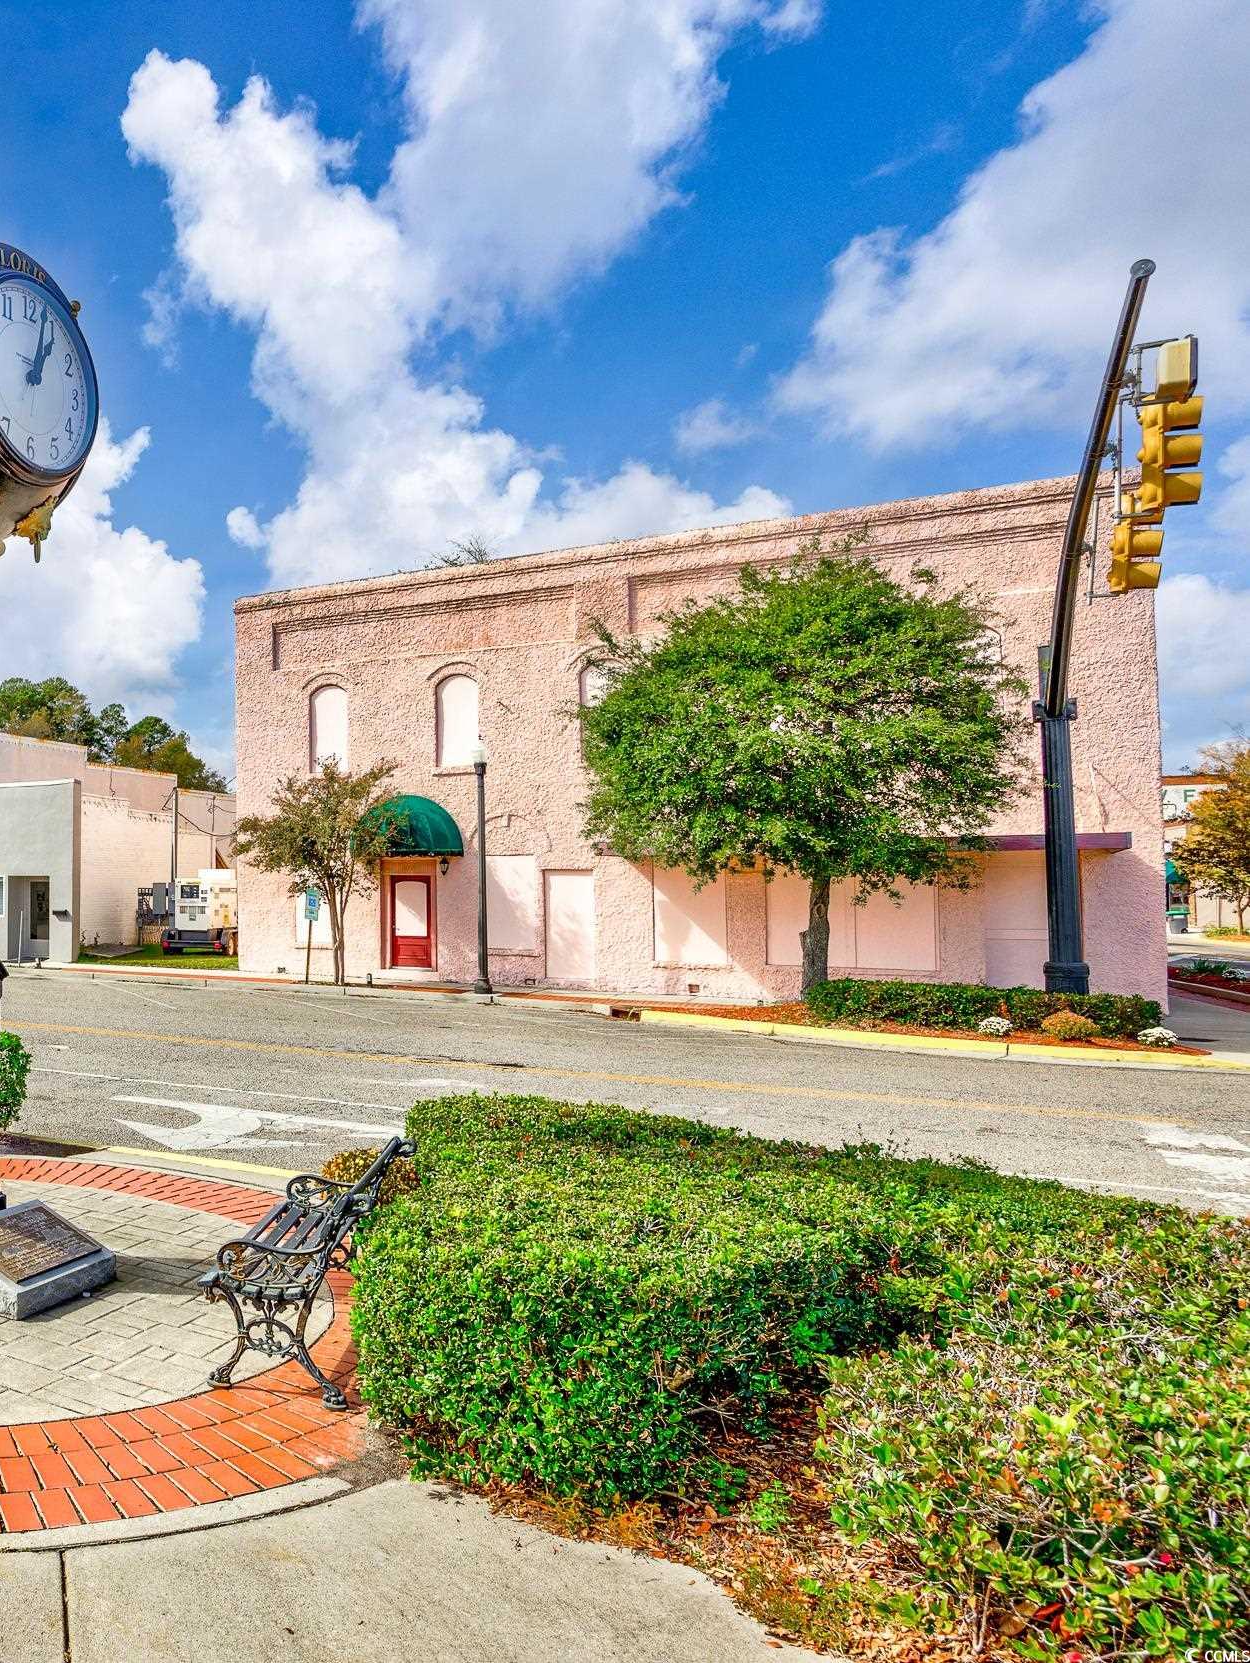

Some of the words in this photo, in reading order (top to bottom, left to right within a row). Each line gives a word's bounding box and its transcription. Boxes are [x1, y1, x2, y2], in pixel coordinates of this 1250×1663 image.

[0, 247, 47, 282] LORIS
[1, 293, 14, 322] 11
[22, 295, 37, 324] 12
[64, 353, 73, 378] 2
[71, 388, 79, 411] 3
[1, 416, 11, 436] 7
[65, 417, 73, 441] 4
[26, 436, 35, 460] 6
[50, 437, 60, 460] 5
